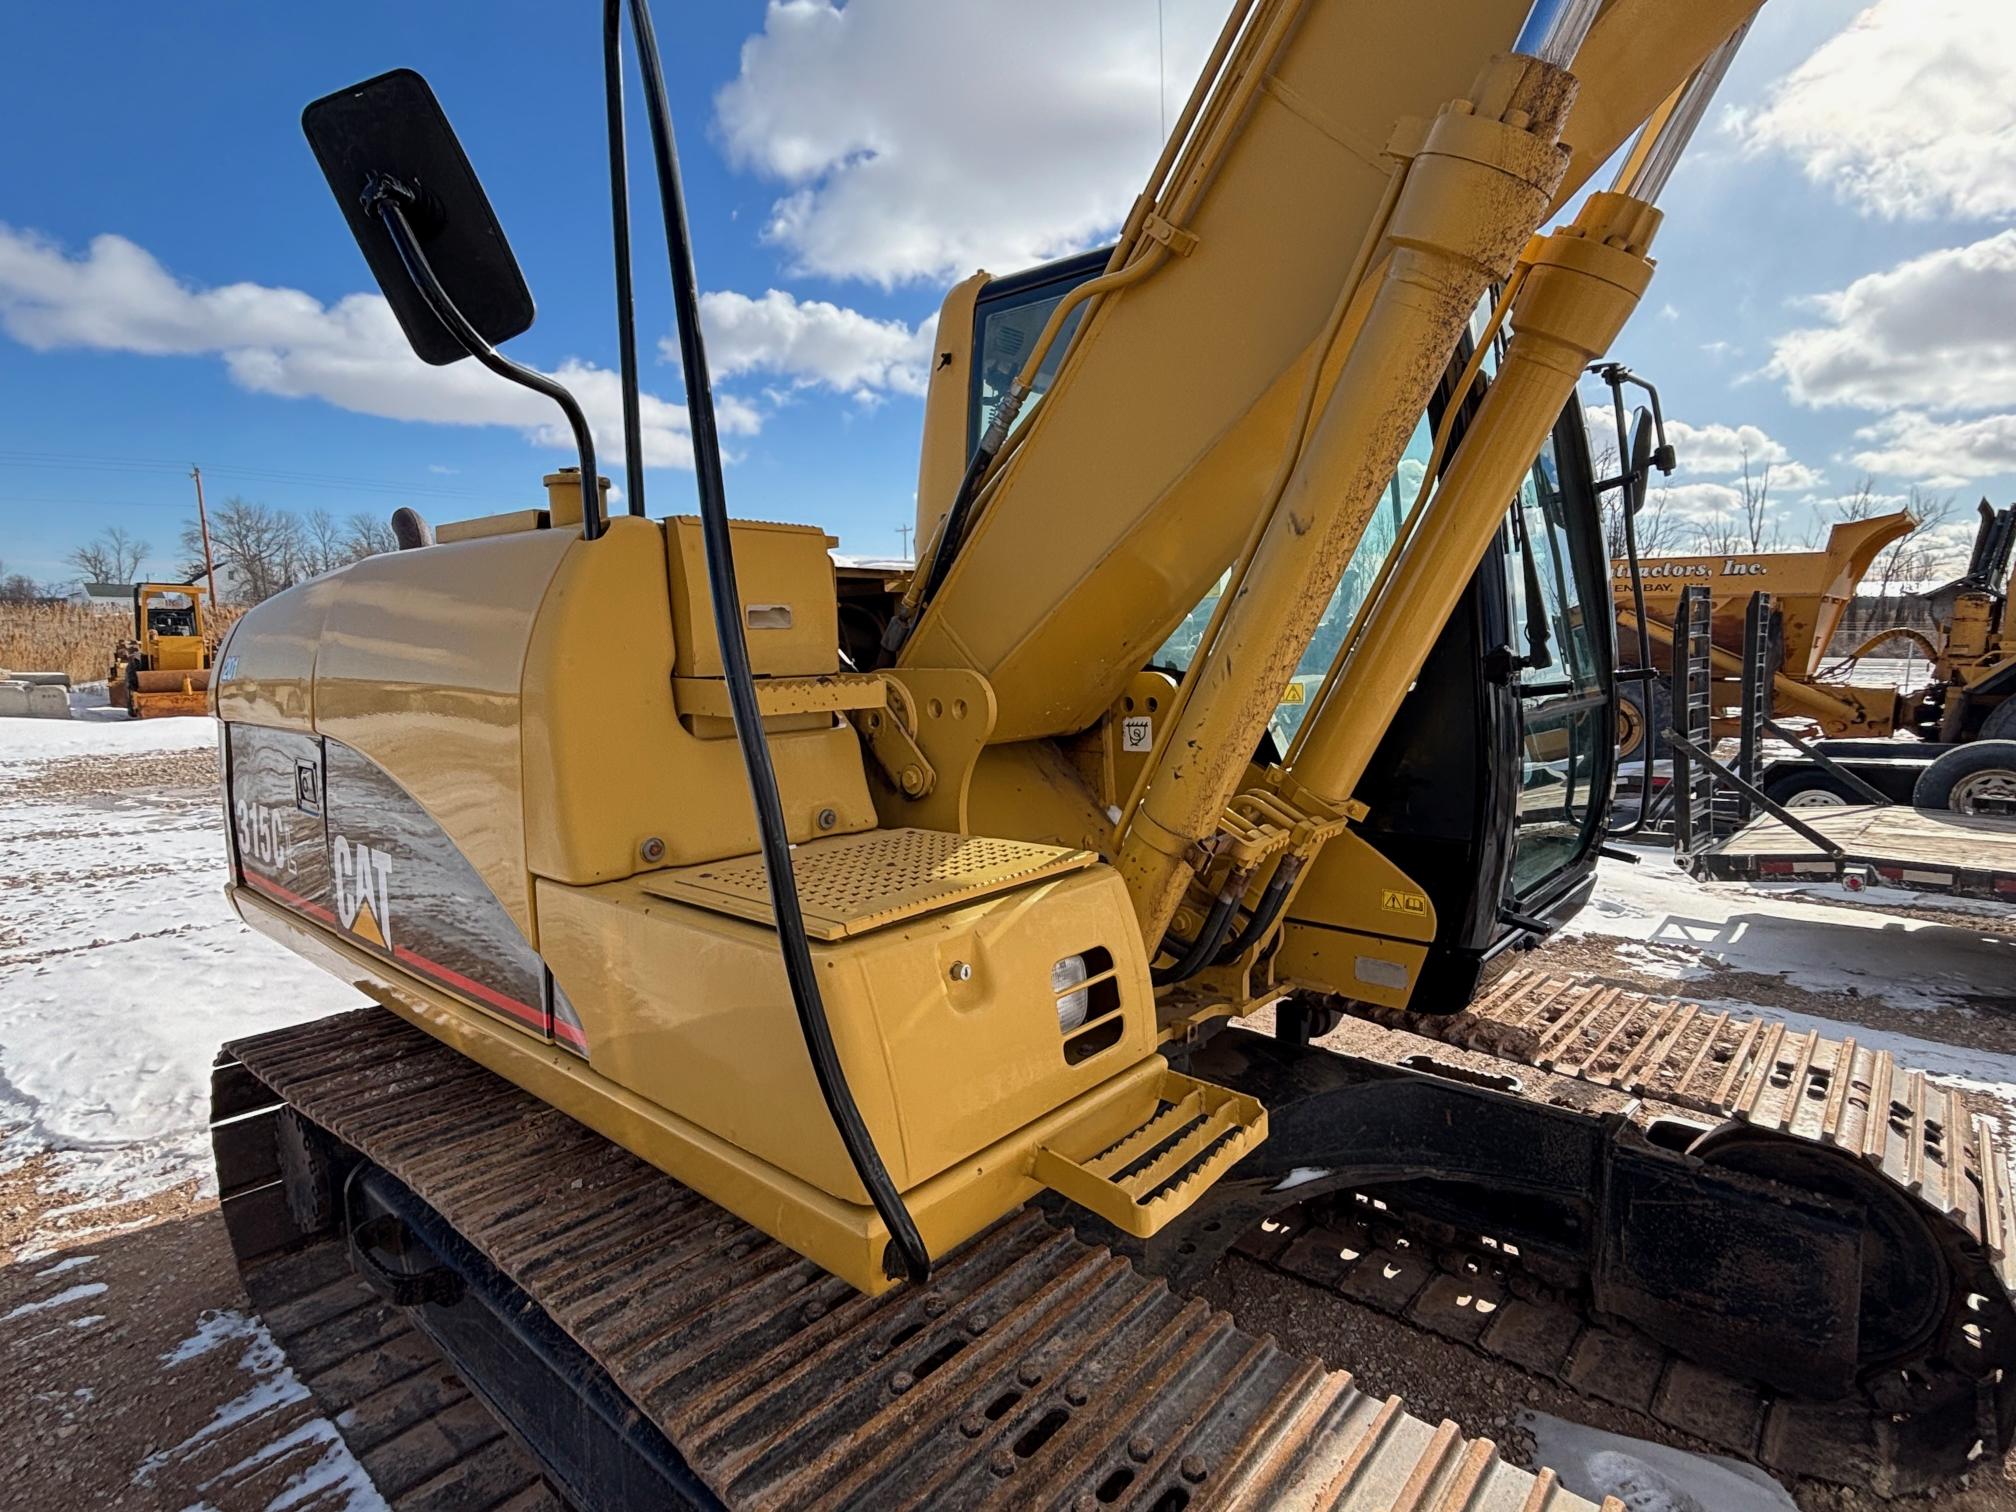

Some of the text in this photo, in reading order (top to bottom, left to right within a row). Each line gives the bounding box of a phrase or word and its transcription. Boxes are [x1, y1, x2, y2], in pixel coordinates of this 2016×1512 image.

[1720, 559, 1767, 577] Inc.
[1643, 583, 1673, 593] BAY,
[333, 835, 393, 951] CAT
